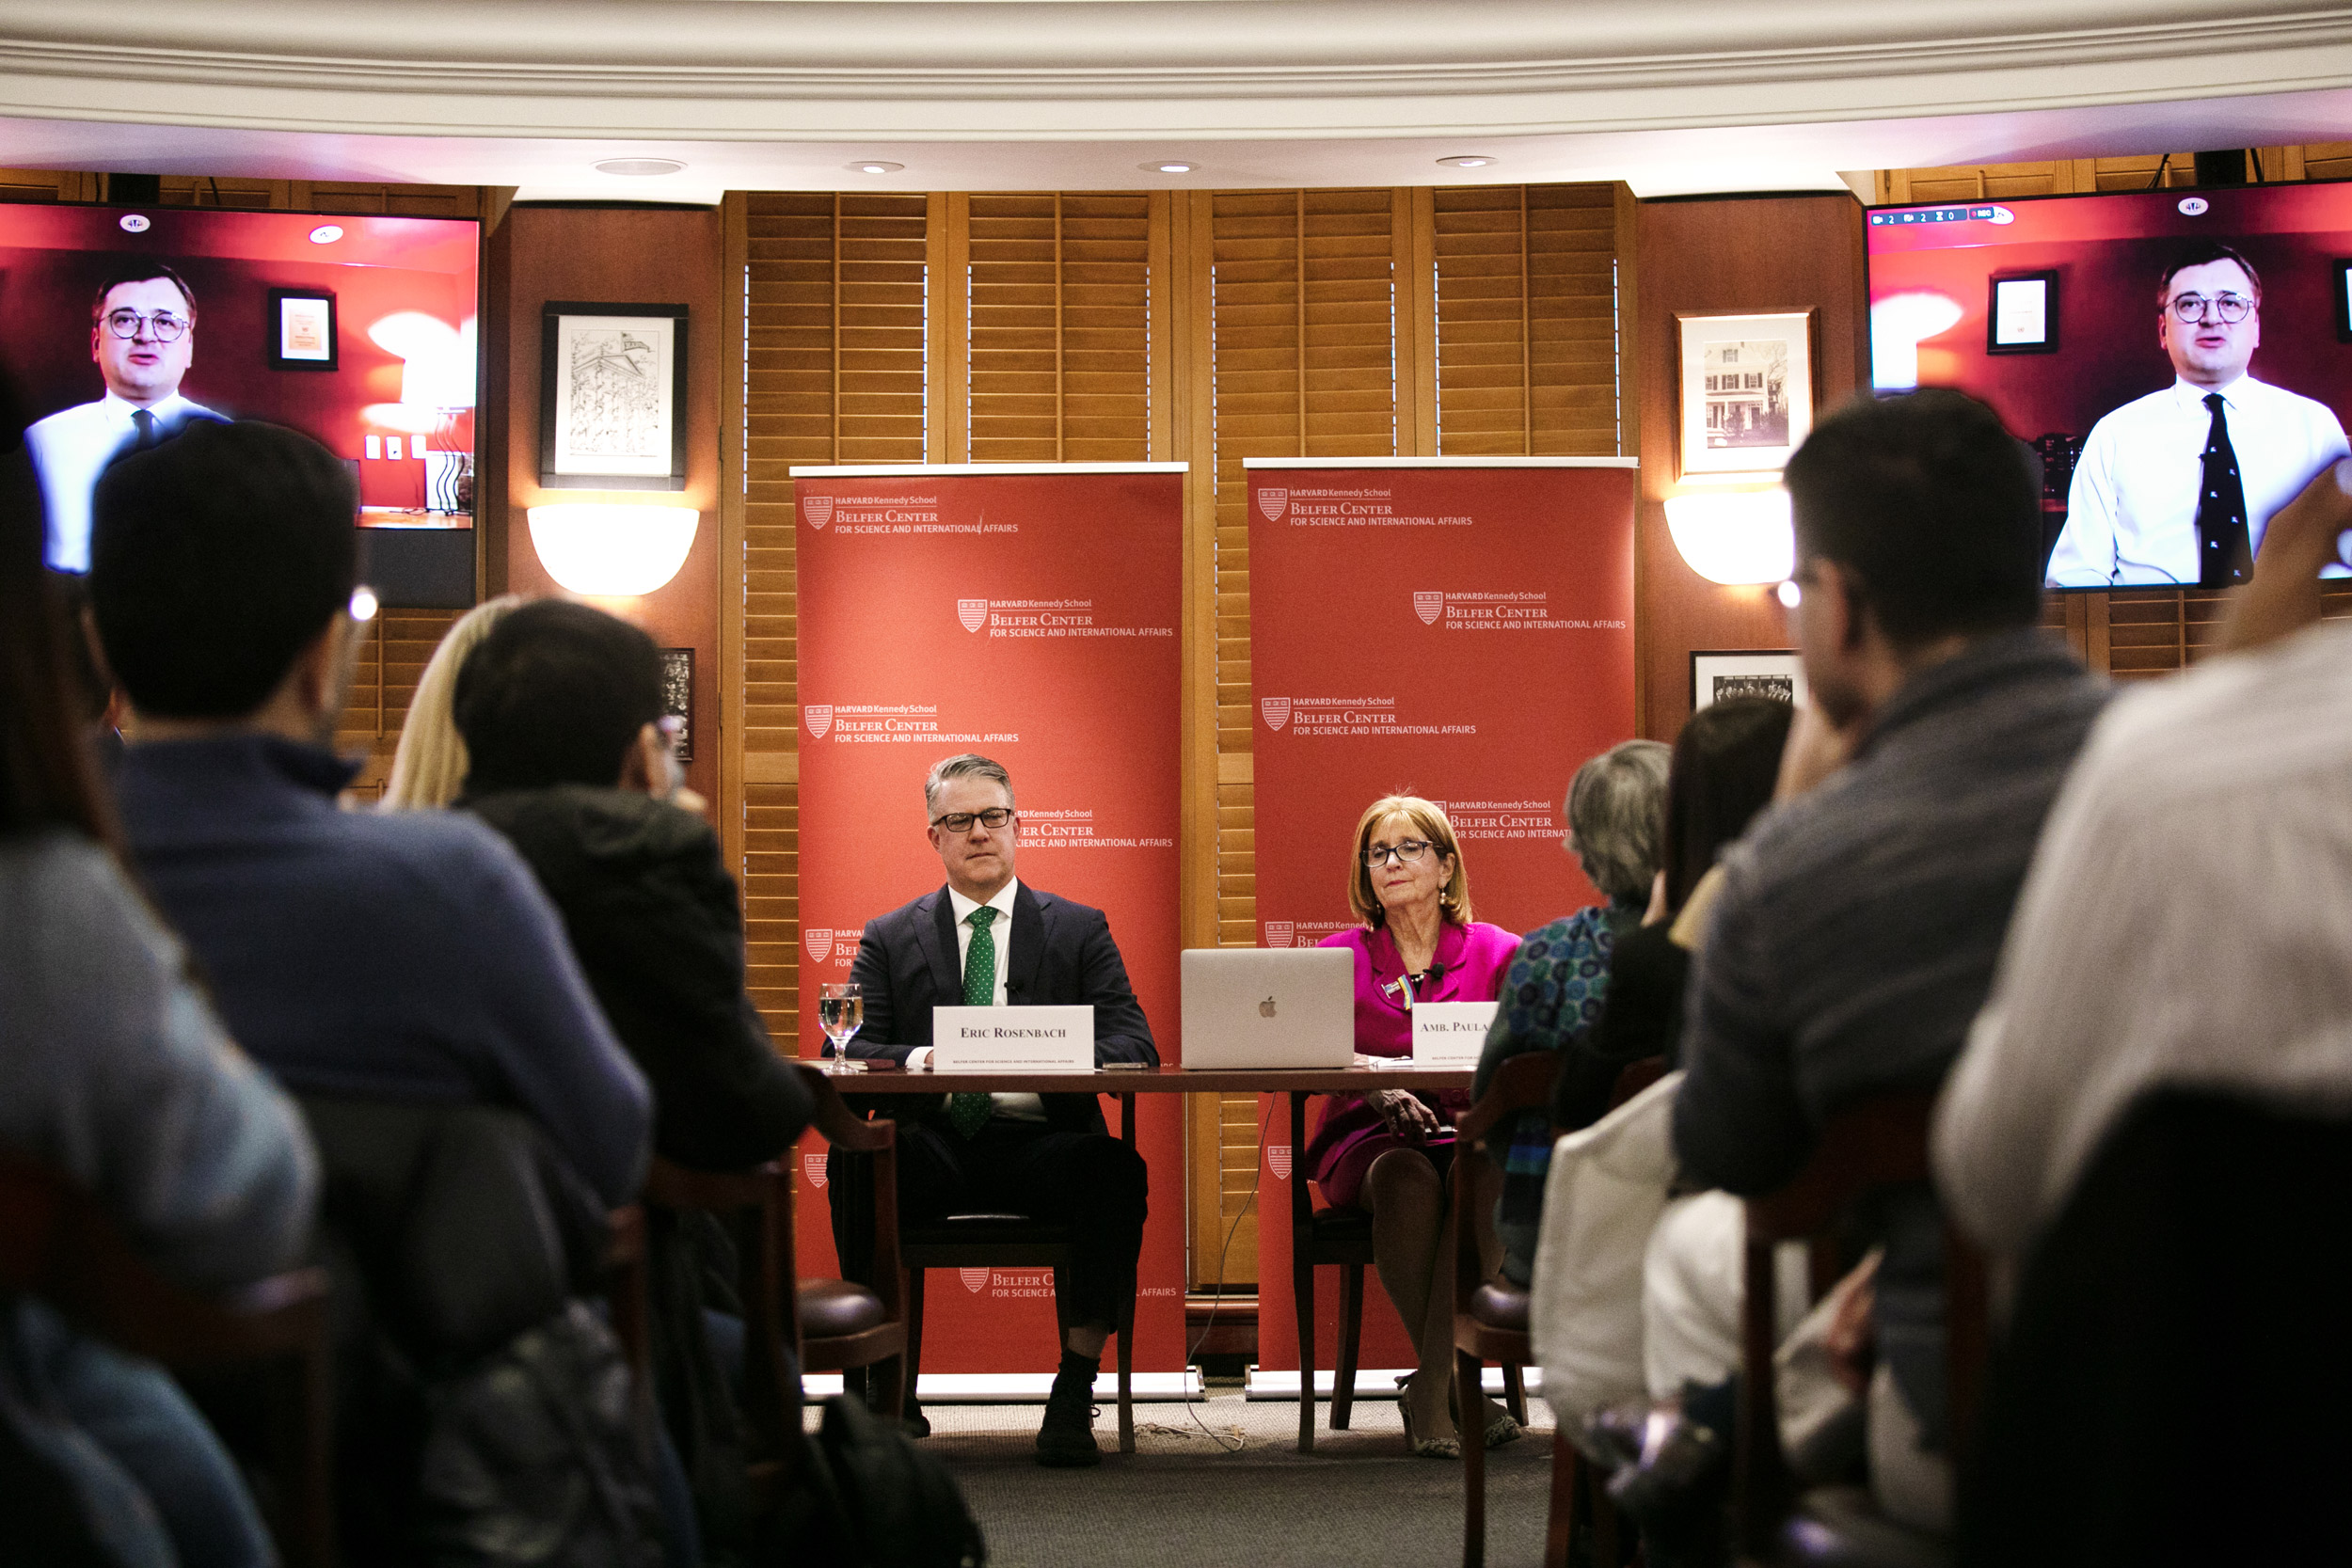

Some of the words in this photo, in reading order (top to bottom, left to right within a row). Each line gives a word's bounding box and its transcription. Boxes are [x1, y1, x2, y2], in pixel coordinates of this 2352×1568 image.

[1329, 488, 1363, 498] Kennedy
[874, 496, 908, 506] Kennedy
[1291, 503, 1337, 514] BELFER
[1340, 501, 1393, 514] CENTER
[836, 511, 882, 522] BELFER
[885, 509, 938, 522] CENTER
[1309, 517, 1345, 526] SCIENCE
[1348, 517, 1365, 525] AND
[1368, 517, 1436, 525] INTERNATIONAL
[1438, 516, 1473, 524] AFFAIRS
[854, 525, 890, 533] SCIENCE
[893, 525, 910, 533] AND
[913, 524, 981, 533] INTERNATIONAL
[983, 524, 1018, 532] AFFAIRS
[1484, 592, 1519, 602] Kennedy
[1029, 599, 1063, 609] Kennedy
[1446, 606, 1492, 617] BELFER
[1495, 605, 1548, 617] CENTER
[991, 614, 1037, 625] BELFER
[1040, 612, 1093, 625] CENTER
[1464, 621, 1500, 629] SCIENCE
[1503, 621, 1521, 629] AND
[1524, 620, 1591, 629] INTERNATIONAL
[1594, 620, 1627, 628] AFFAIRS
[1009, 628, 1045, 636] SCIENCE
[1048, 628, 1065, 636] AND
[1068, 628, 1135, 636] INTERNATIONAL
[1138, 627, 1173, 635] AFFAIRS
[1332, 697, 1366, 707] Kennedy
[874, 705, 908, 715] Kennedy
[1294, 711, 1340, 723] BELFER
[1343, 710, 1396, 723] CENTER
[836, 719, 882, 731] BELFER
[885, 718, 938, 731] CENTER
[1312, 726, 1348, 734] SCIENCE
[1351, 726, 1368, 734] AND
[1371, 725, 1439, 734] INTERNATIONAL
[1441, 725, 1476, 733] AFFAIRS
[854, 734, 890, 742] SCIENCE
[893, 734, 910, 742] AND
[913, 733, 981, 742] INTERNATIONAL
[983, 733, 1018, 741] AFFAIRS
[1030, 810, 1064, 818] Kennedy
[1450, 815, 1497, 827] BELFER
[1499, 815, 1552, 827] CENTER
[1041, 824, 1093, 836] CENTER
[1421, 1023, 1449, 1031] AMB.
[1453, 1022, 1489, 1031] PAULA
[961, 1028, 990, 1038] ERIC
[995, 1028, 1065, 1038] ROSENBACH
[993, 1274, 1039, 1285] BELFER
[1012, 1289, 1048, 1297] SCIENCE
